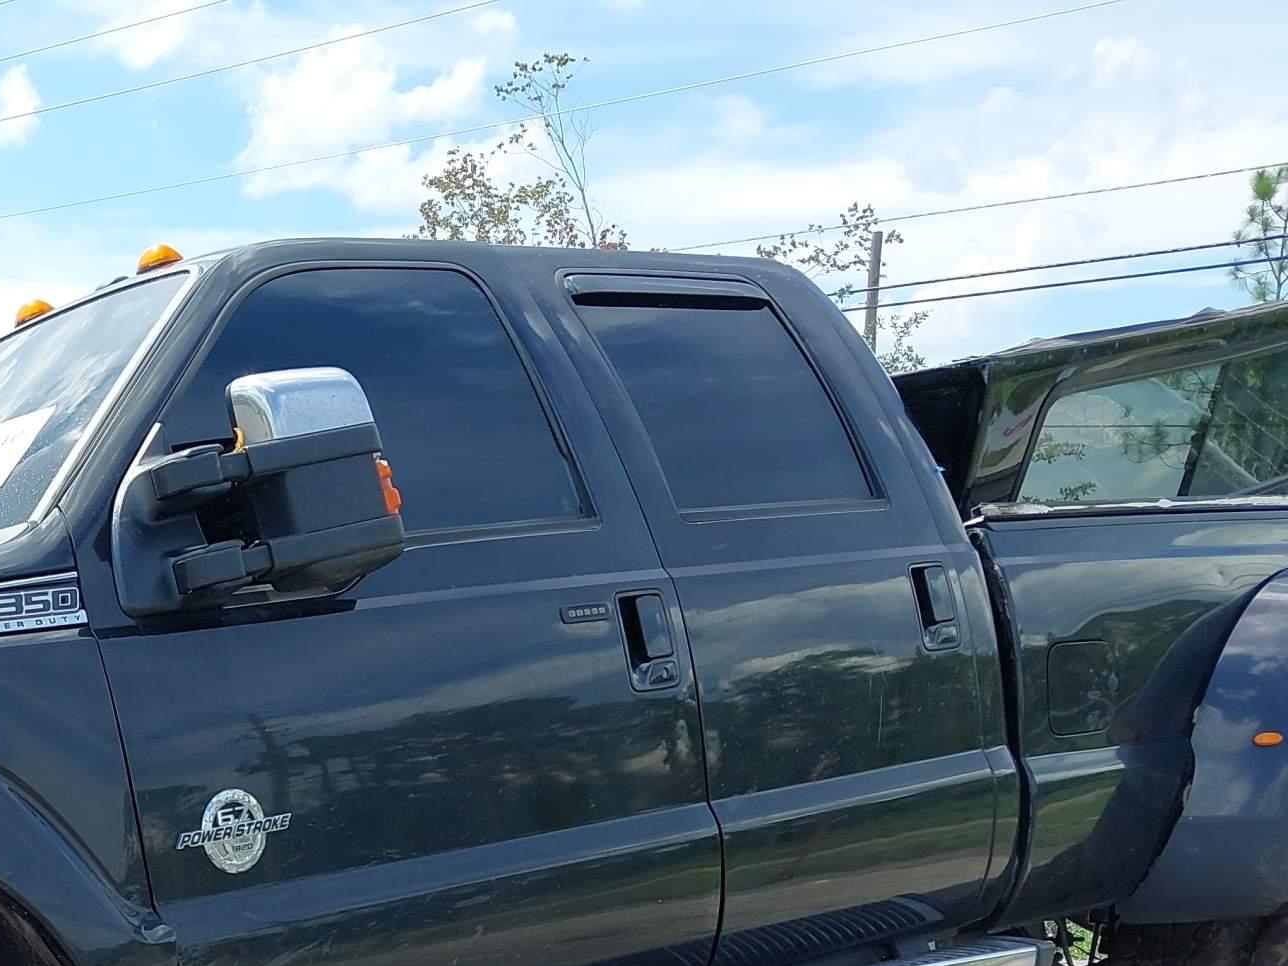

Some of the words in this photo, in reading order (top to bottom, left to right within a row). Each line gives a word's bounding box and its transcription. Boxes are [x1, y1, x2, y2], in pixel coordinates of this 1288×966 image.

[35, 613, 82, 627] DUTY
[176, 826, 233, 850] POWER
[234, 812, 292, 839] STROKE
